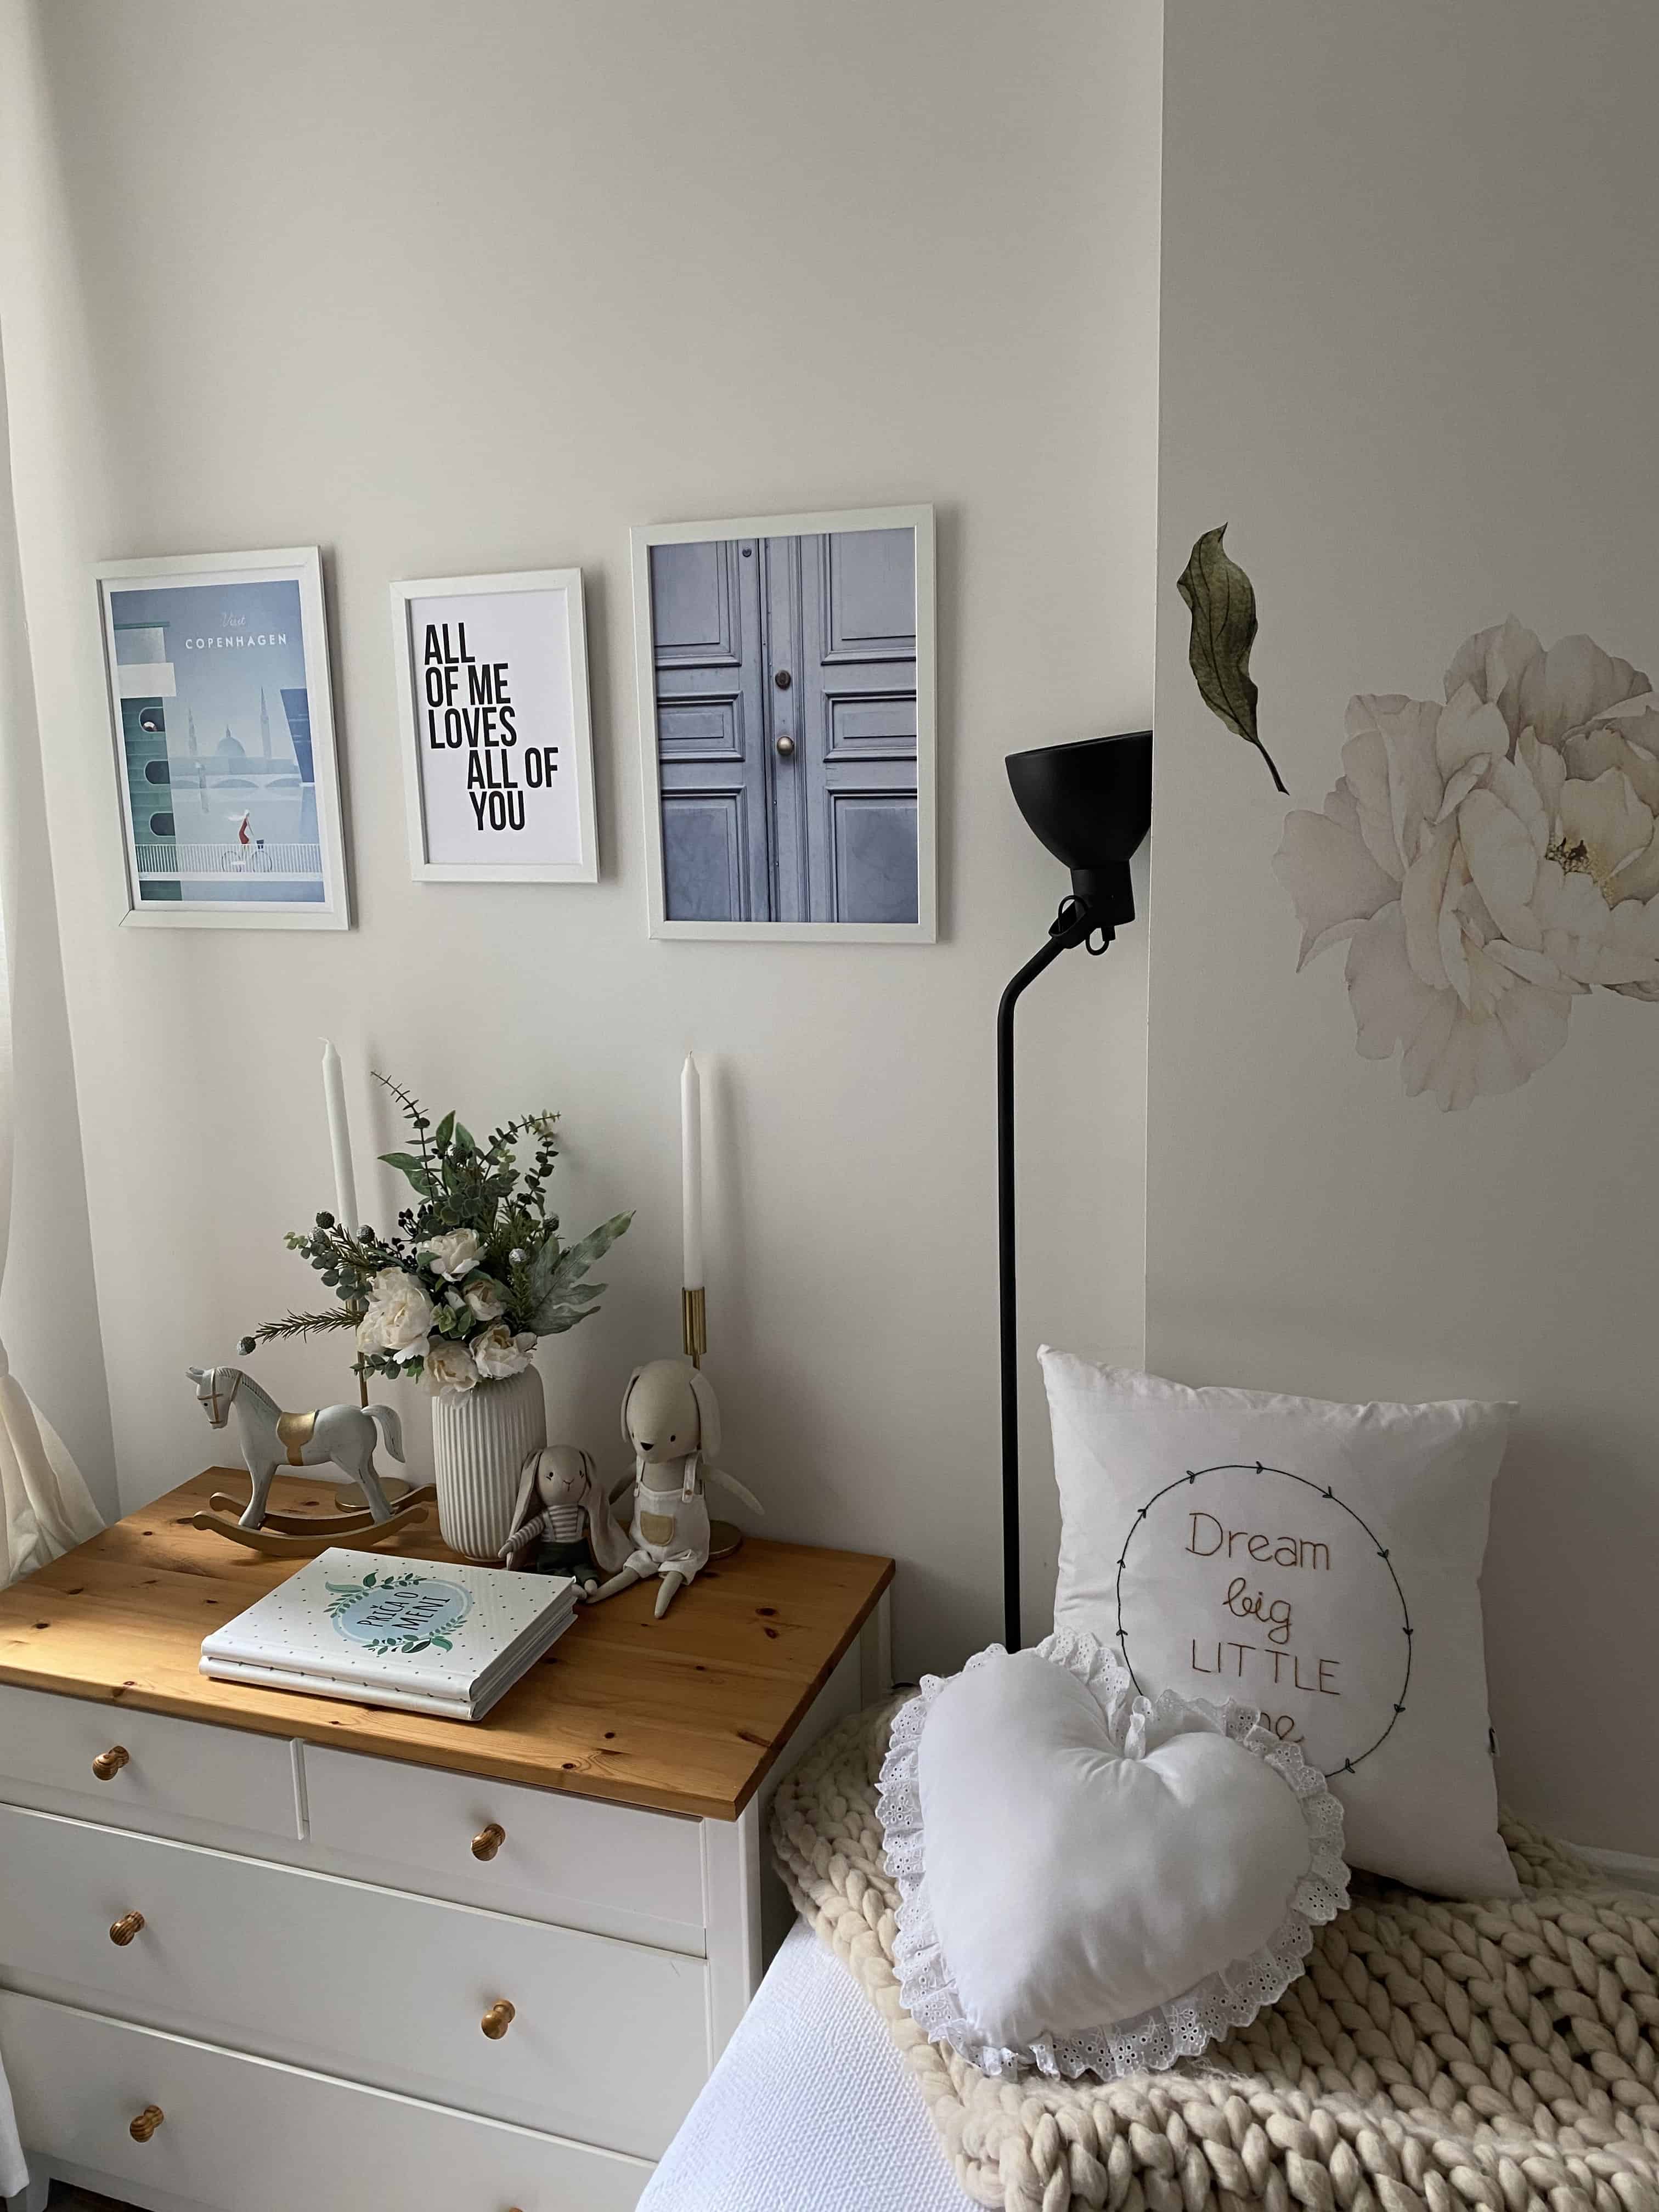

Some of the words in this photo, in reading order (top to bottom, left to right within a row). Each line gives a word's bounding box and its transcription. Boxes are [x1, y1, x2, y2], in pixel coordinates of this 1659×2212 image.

[185, 633, 287, 650] COPENHAGEN
[424, 622, 475, 665] ALL
[426, 666, 459, 707] OF
[467, 663, 511, 706] ME
[428, 707, 517, 749] LOVES
[467, 749, 518, 789] ALL
[524, 747, 558, 789] OF
[470, 790, 526, 831] YOU
[1186, 1512, 1331, 1571] Dream
[357, 1601, 410, 1627] PRIČA
[391, 1596, 450, 1630] MENI
[1222, 1577, 1293, 1645] big
[1192, 1639, 1341, 1695] LITTLE
[1260, 1712, 1305, 1743] ne
